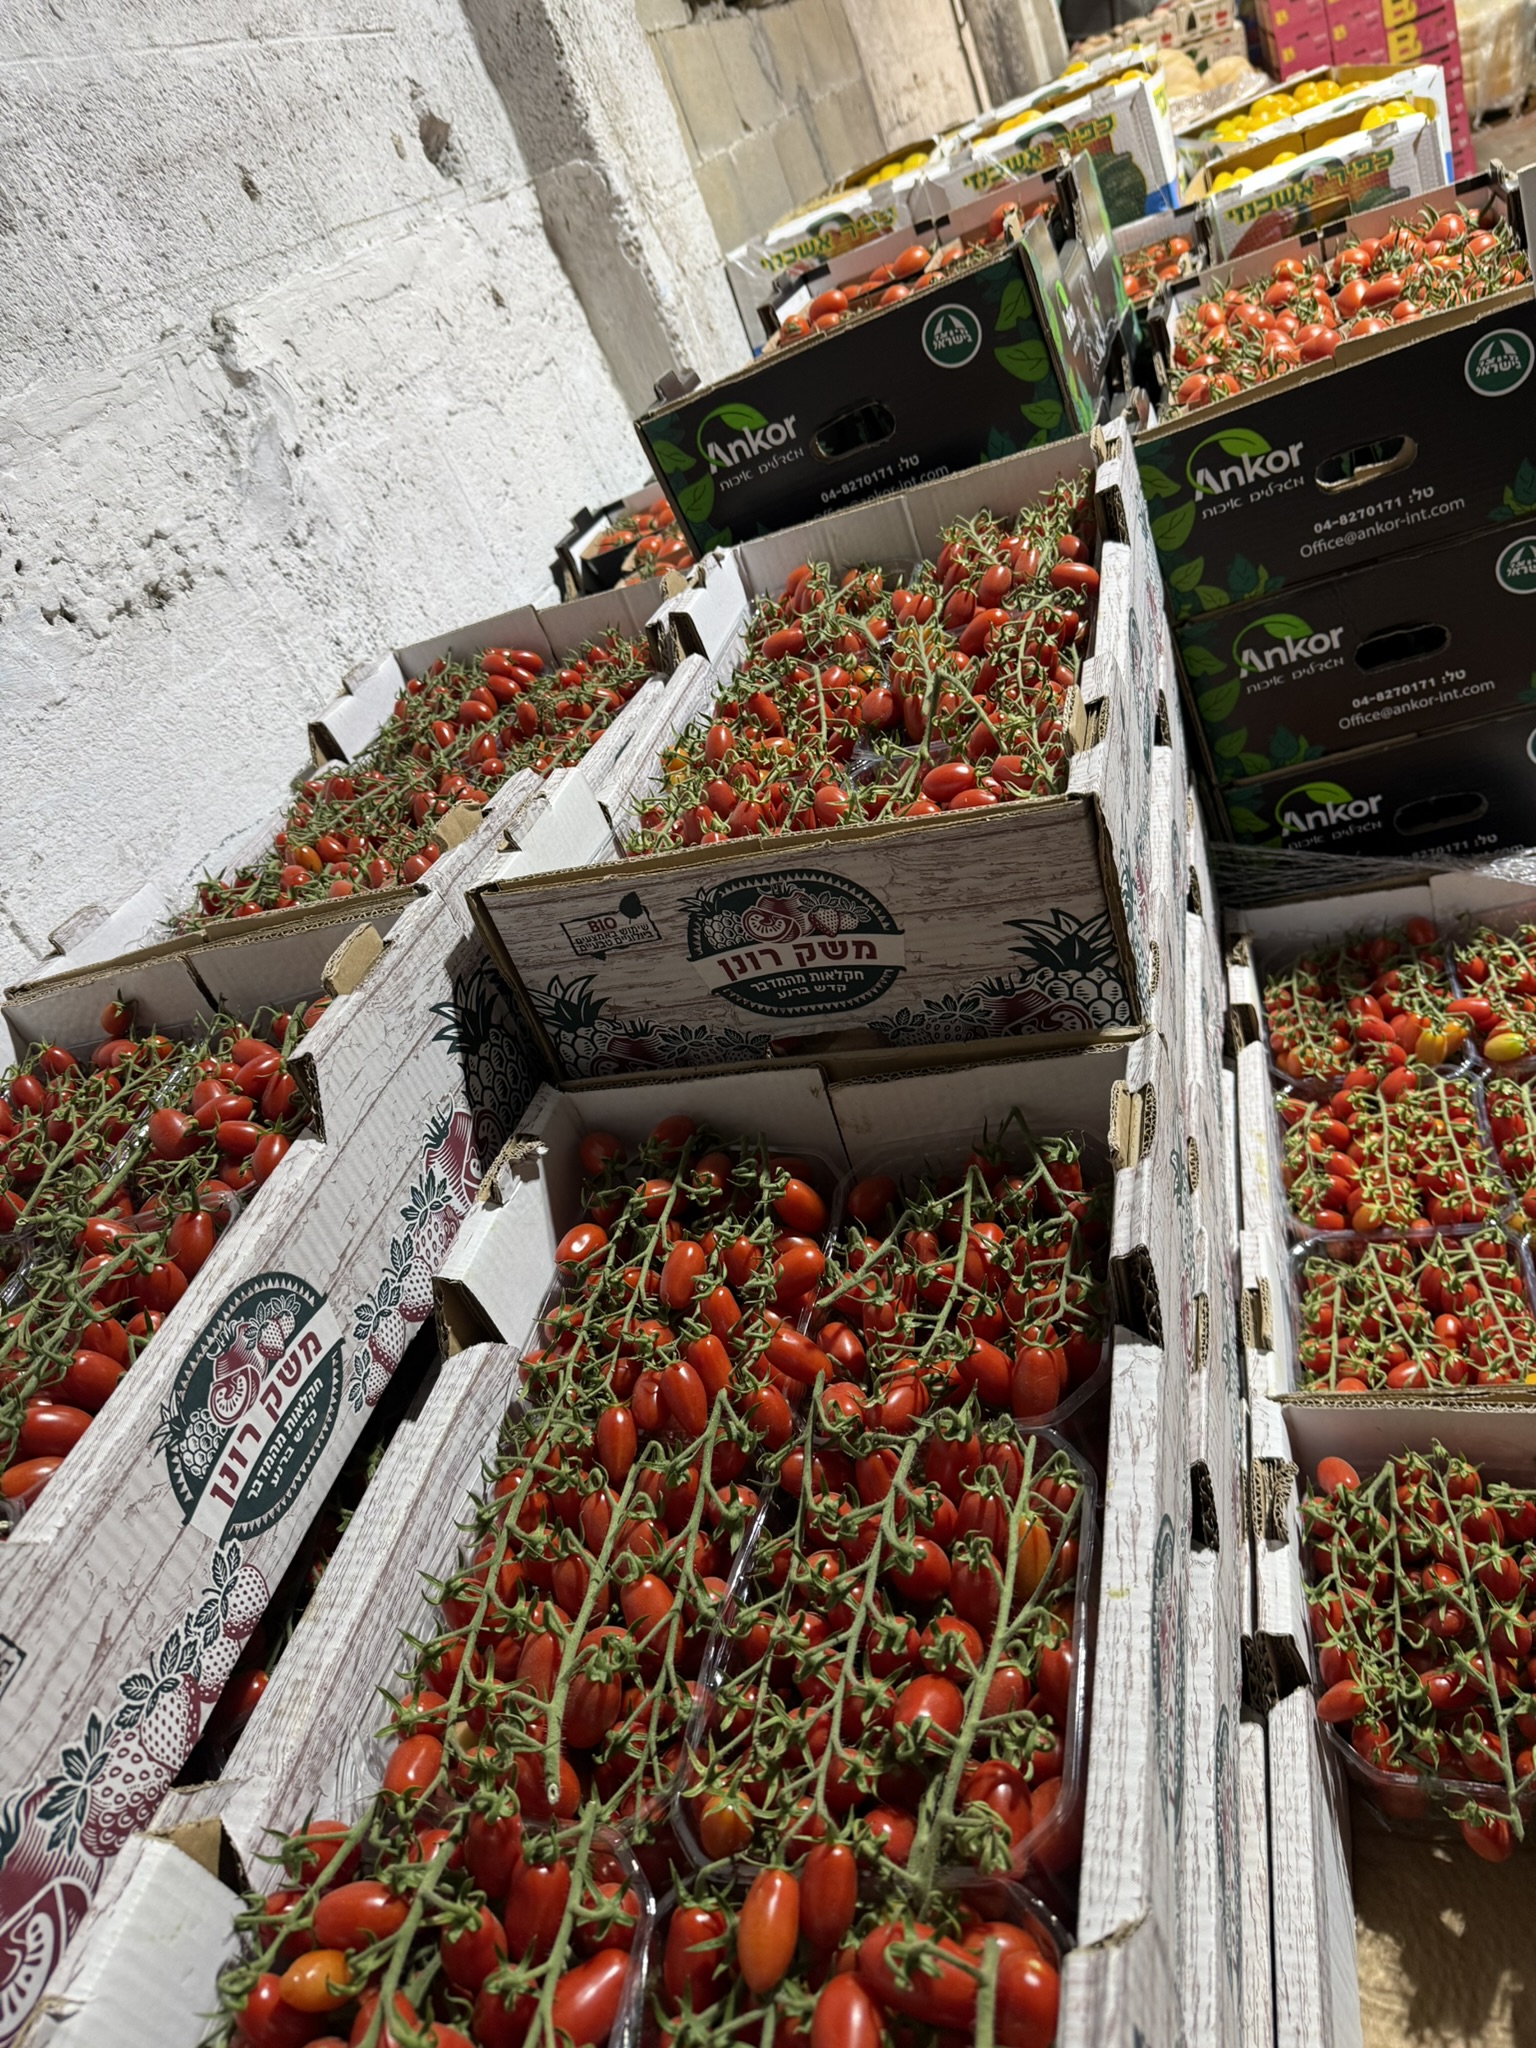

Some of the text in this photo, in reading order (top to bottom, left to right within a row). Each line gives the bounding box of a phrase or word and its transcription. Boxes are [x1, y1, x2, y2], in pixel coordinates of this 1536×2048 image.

[1053, 113, 1117, 151] כפיר
[1224, 147, 1394, 225] כפיר אשכנזי
[760, 232, 833, 272] אשכנזי
[707, 414, 796, 475] Ankor
[820, 454, 920, 503] טל: 04-8270171
[1195, 441, 1304, 502] Ankor
[1300, 498, 1466, 558] Office@ankor-int.com
[1313, 486, 1434, 534] טל: 04-8270171
[1240, 626, 1344, 679] Ankor
[1338, 680, 1496, 730] Office@ankor-int.com
[1352, 669, 1467, 708] טל: 04-8270171
[1282, 794, 1382, 837] Ankor
[587, 917, 617, 933] BIO
[619, 924, 649, 935] שימוש
[717, 940, 878, 981] משק רונן
[750, 969, 864, 993] חקלאות מהמדבר
[777, 983, 847, 1000] קדש ברנע
[209, 1331, 322, 1509] משק רונן
[247, 1377, 324, 1500] חקלאות מהמדבר
[271, 1408, 318, 1487] קדש ברנע
